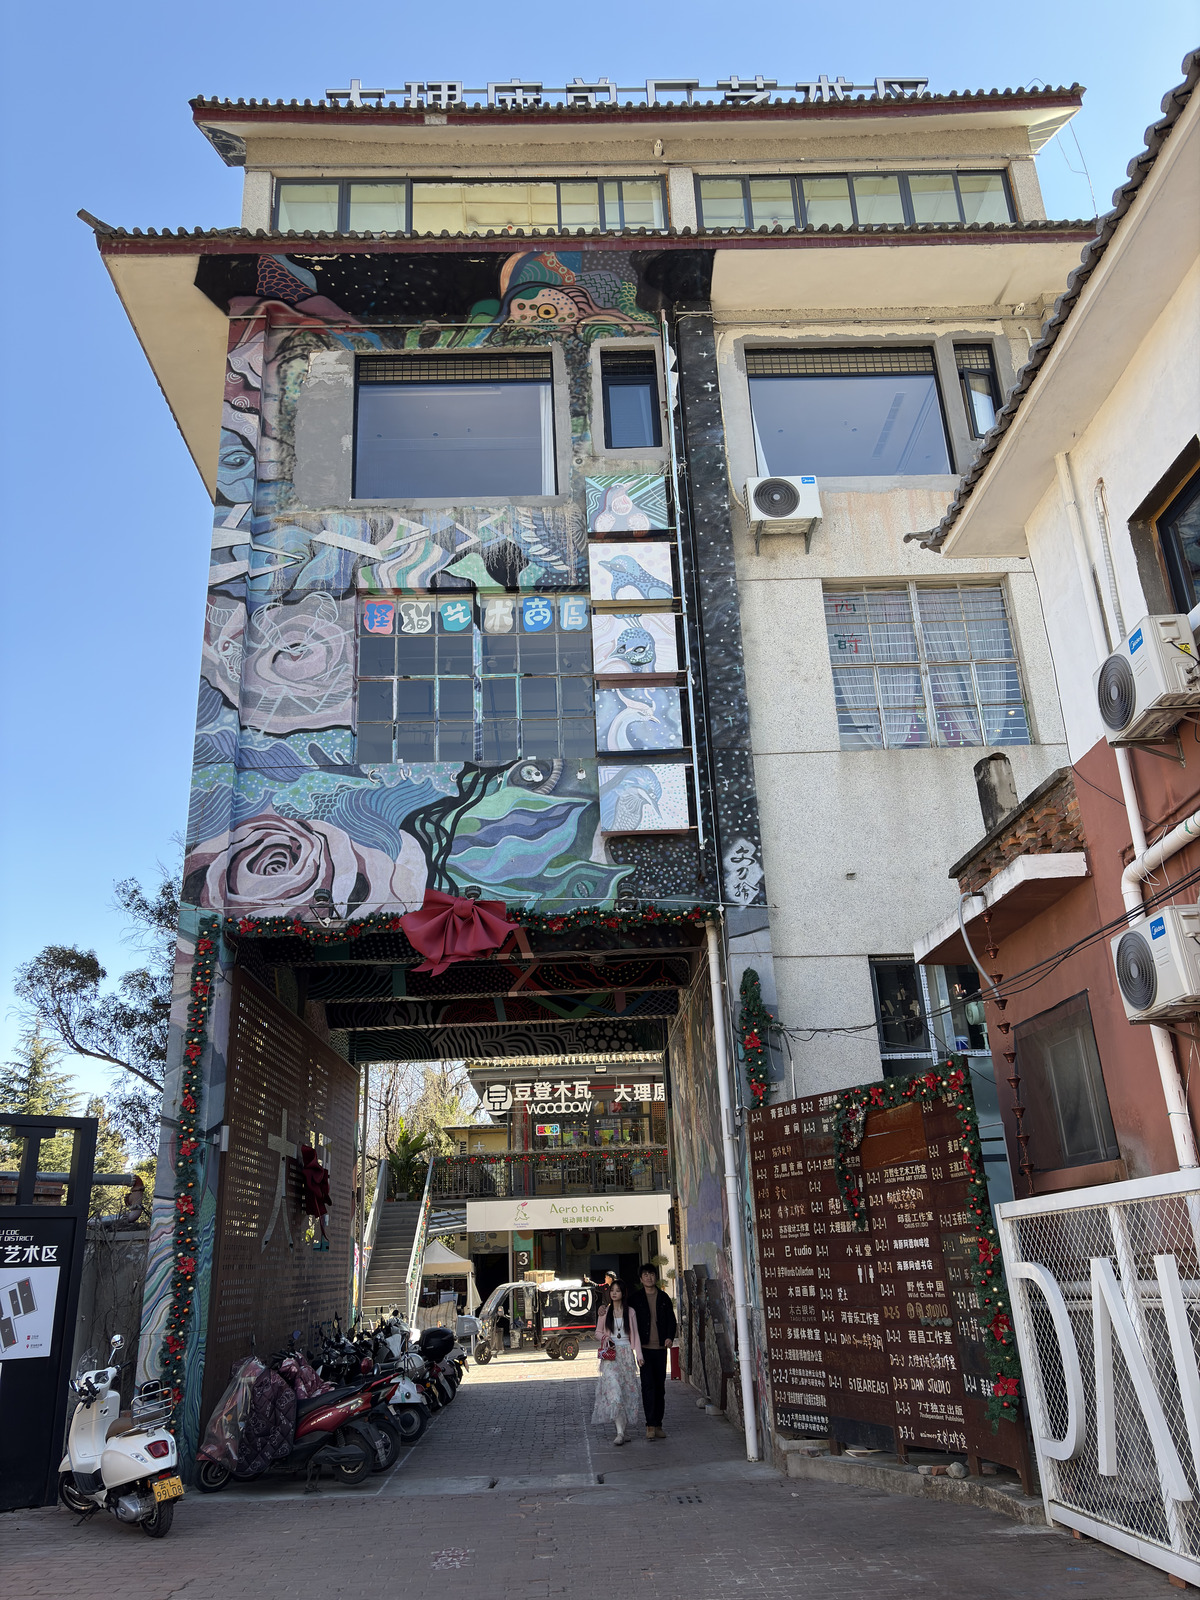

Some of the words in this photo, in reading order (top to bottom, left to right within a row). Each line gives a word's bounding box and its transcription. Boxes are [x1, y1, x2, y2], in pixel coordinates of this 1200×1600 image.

[514, 1081, 592, 1104] 豆登木瓦
[549, 1203, 578, 1214] Aero
[581, 1201, 615, 1213] tennis
[0, 1245, 58, 1263] 艺术区
[846, 1244, 873, 1257] 小礼堂
[519, 1251, 529, 1266] 3
[906, 1280, 945, 1292] 野性中国
[787, 1327, 821, 1341] 多媒体教室
[908, 1330, 953, 1345] 程昌工作室
[918, 1401, 964, 1416] 7寸独立出版
[156, 1485, 183, 1501] 99L08
